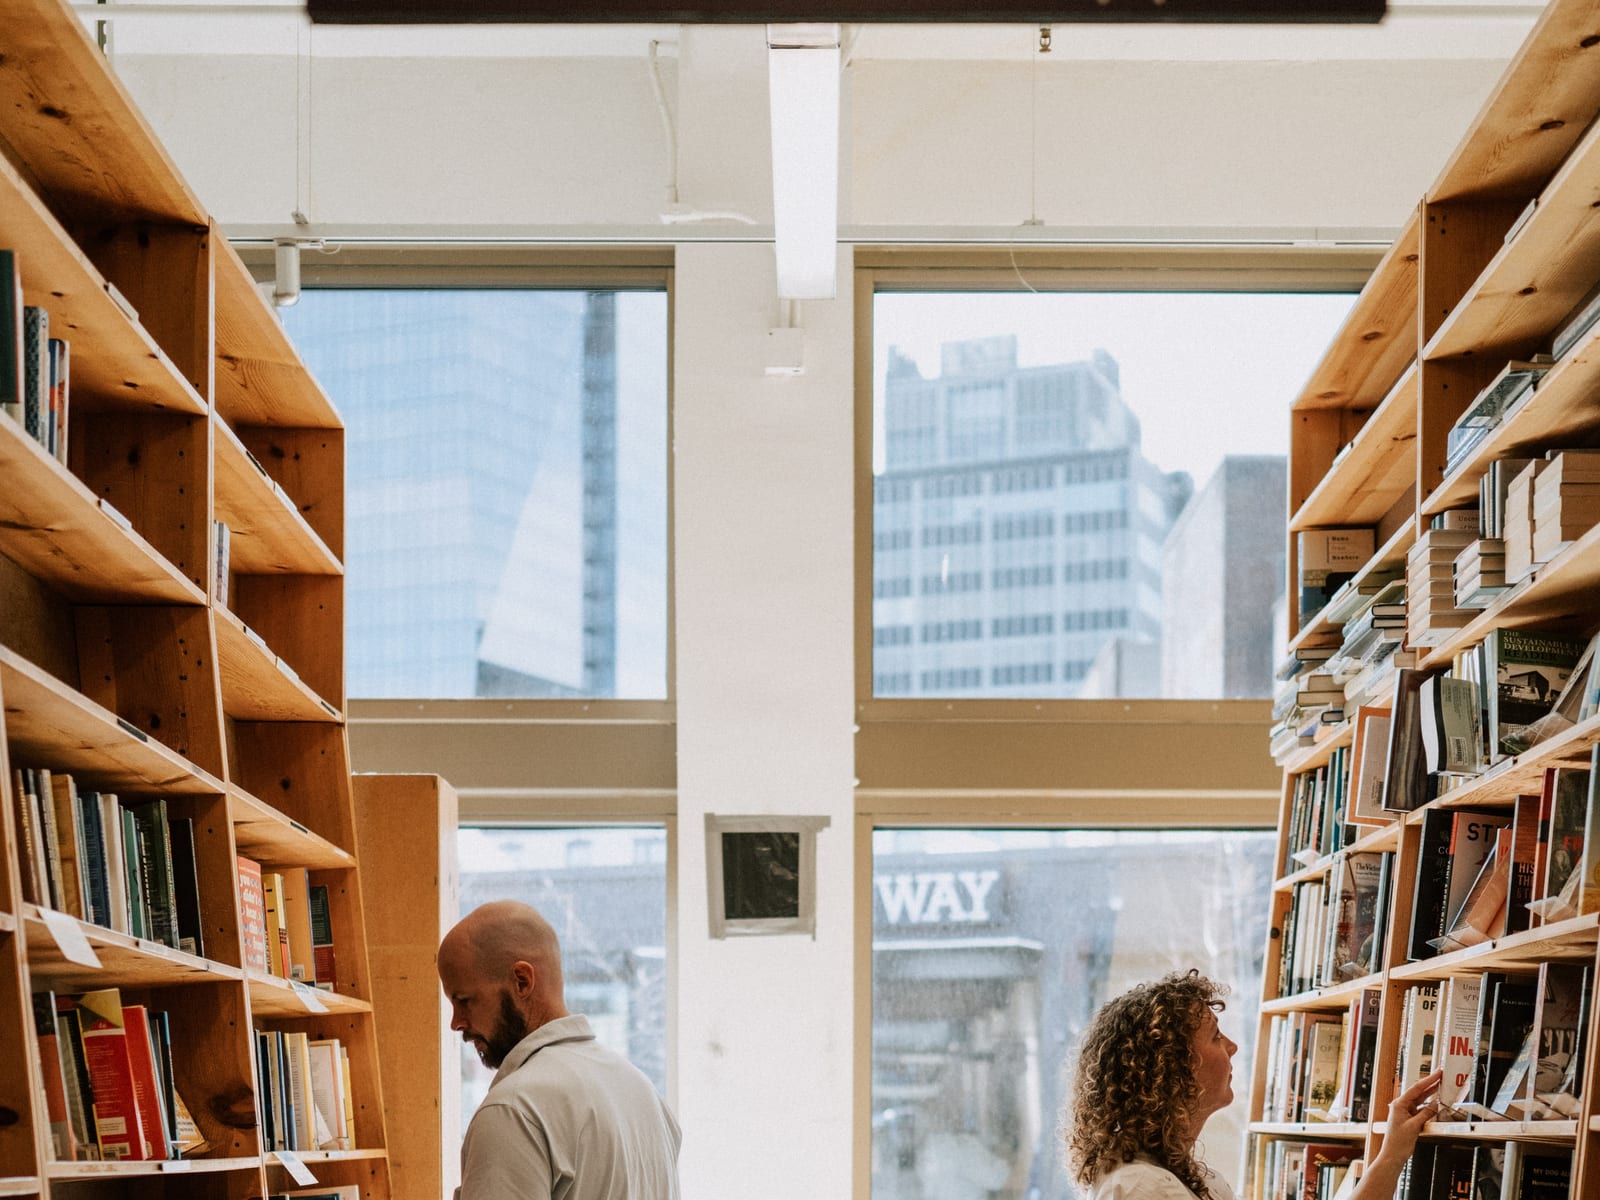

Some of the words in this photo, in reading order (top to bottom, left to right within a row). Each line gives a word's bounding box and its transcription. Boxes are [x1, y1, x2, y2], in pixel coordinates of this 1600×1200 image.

[1503, 630, 1519, 638] THE
[1503, 642, 1580, 657] DEVELOPMENT
[876, 871, 1000, 924] WAY
[1417, 985, 1438, 998] THE
[1422, 1000, 1436, 1011] OF
